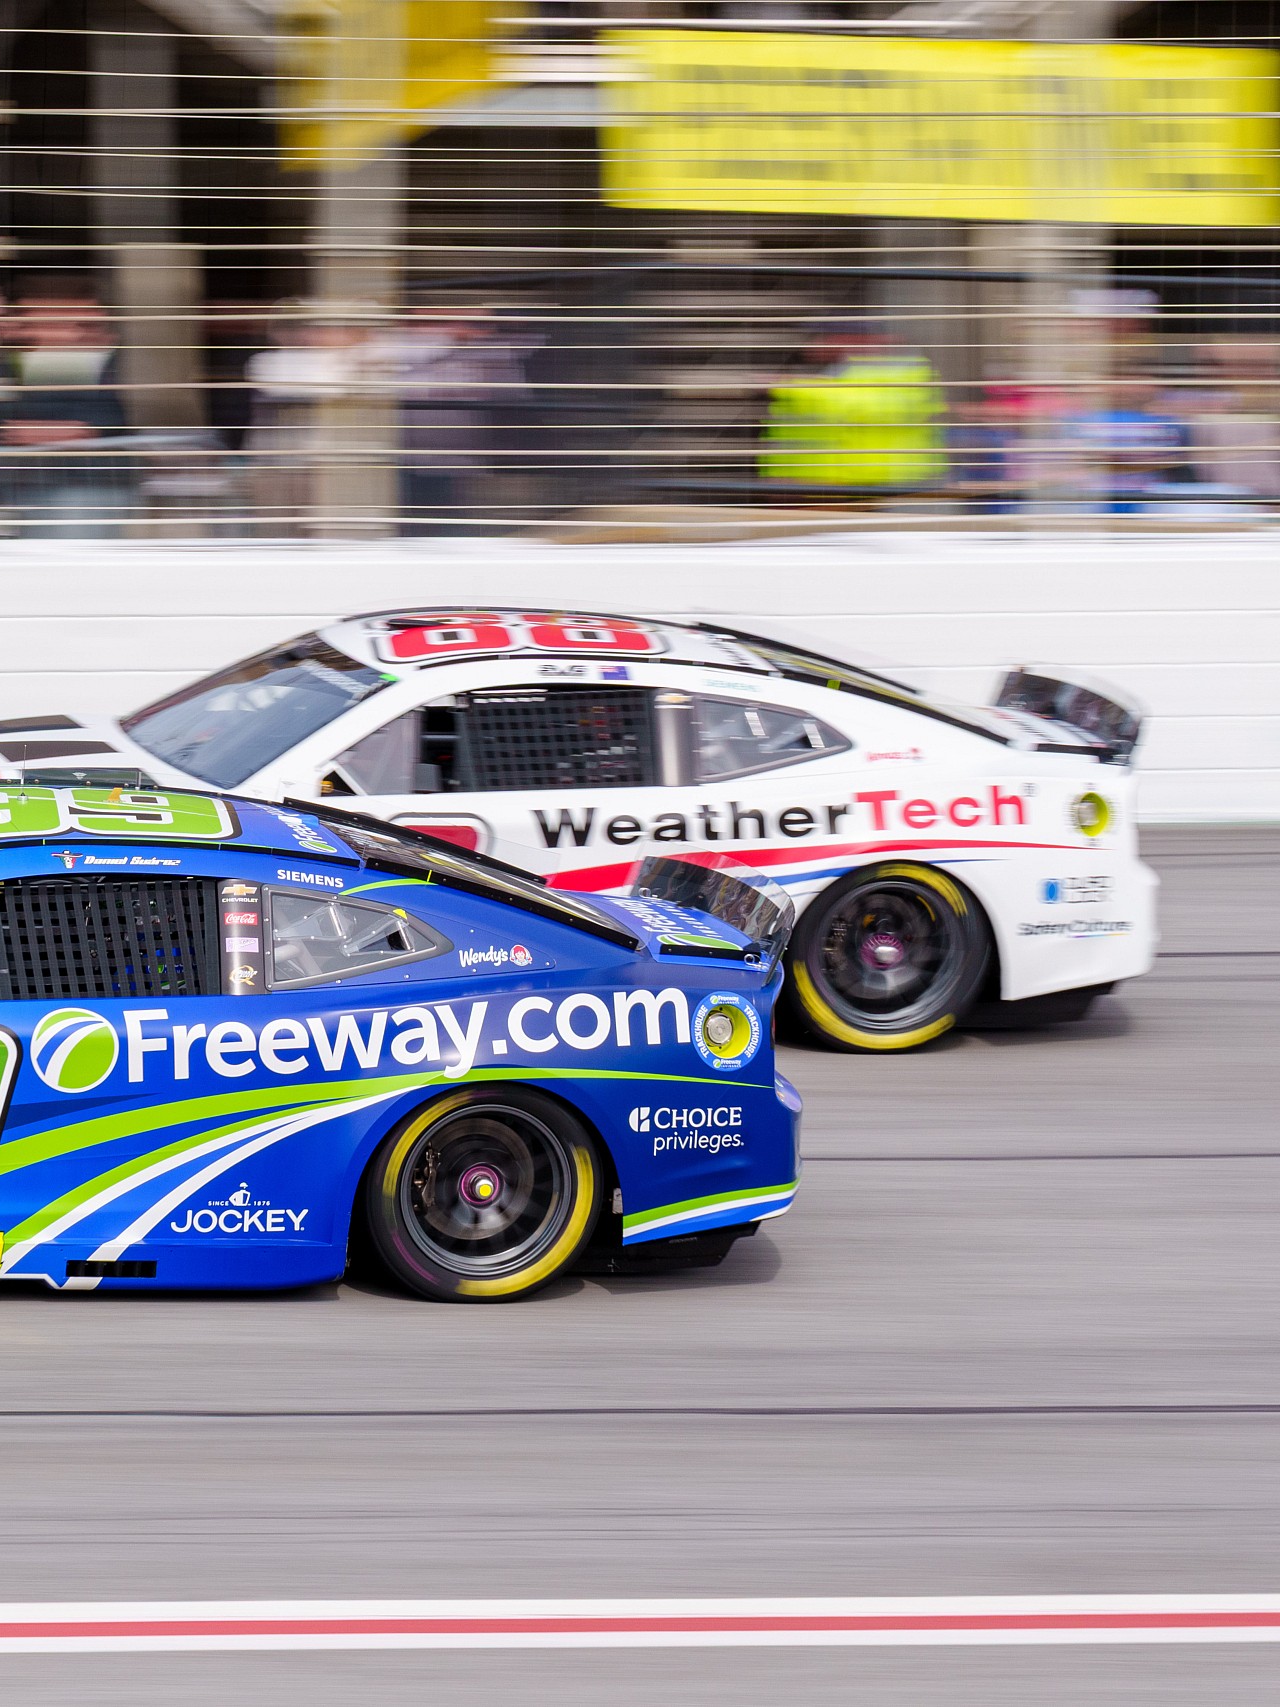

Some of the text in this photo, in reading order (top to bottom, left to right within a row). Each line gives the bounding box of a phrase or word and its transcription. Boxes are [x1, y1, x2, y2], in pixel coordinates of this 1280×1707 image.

[374, 612, 670, 664] 88
[533, 784, 1029, 848] WeatherTech
[84, 855, 128, 865] Daniel
[277, 869, 344, 888] SIEMENS
[459, 945, 508, 967] Wendy's
[123, 987, 690, 1082] Freeway.com
[694, 1004, 709, 1058] TRACKHOUSE
[743, 1004, 760, 1058] TRACKHOUSE
[653, 1107, 742, 1129] CHOICE
[171, 1209, 309, 1233] JOCKEY
